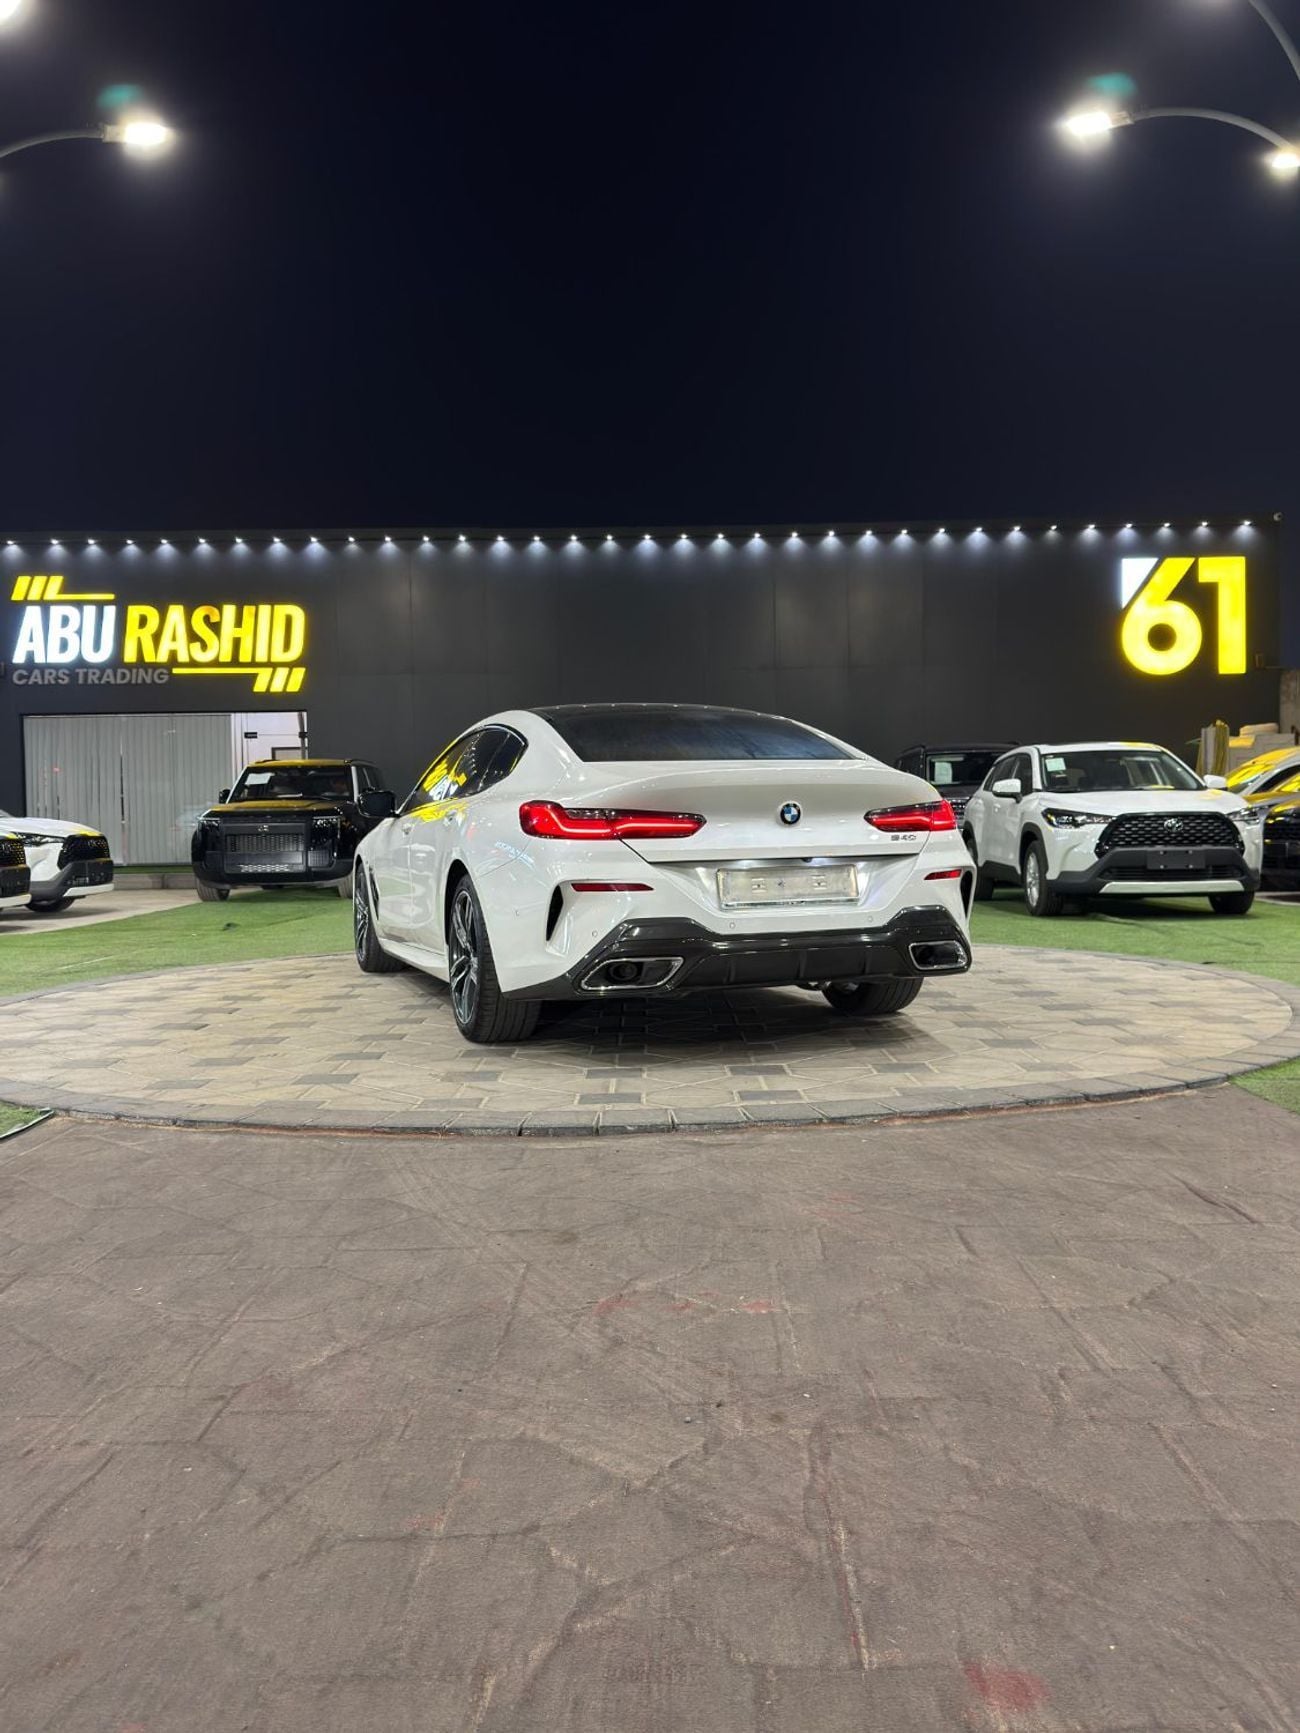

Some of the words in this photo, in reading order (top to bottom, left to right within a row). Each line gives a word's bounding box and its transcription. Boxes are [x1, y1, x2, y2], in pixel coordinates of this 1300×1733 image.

[12, 604, 116, 664] ABU
[123, 604, 305, 663] RASHID
[1121, 556, 1246, 675] 61
[12, 668, 70, 685] CARS
[75, 667, 169, 684] TRADING
